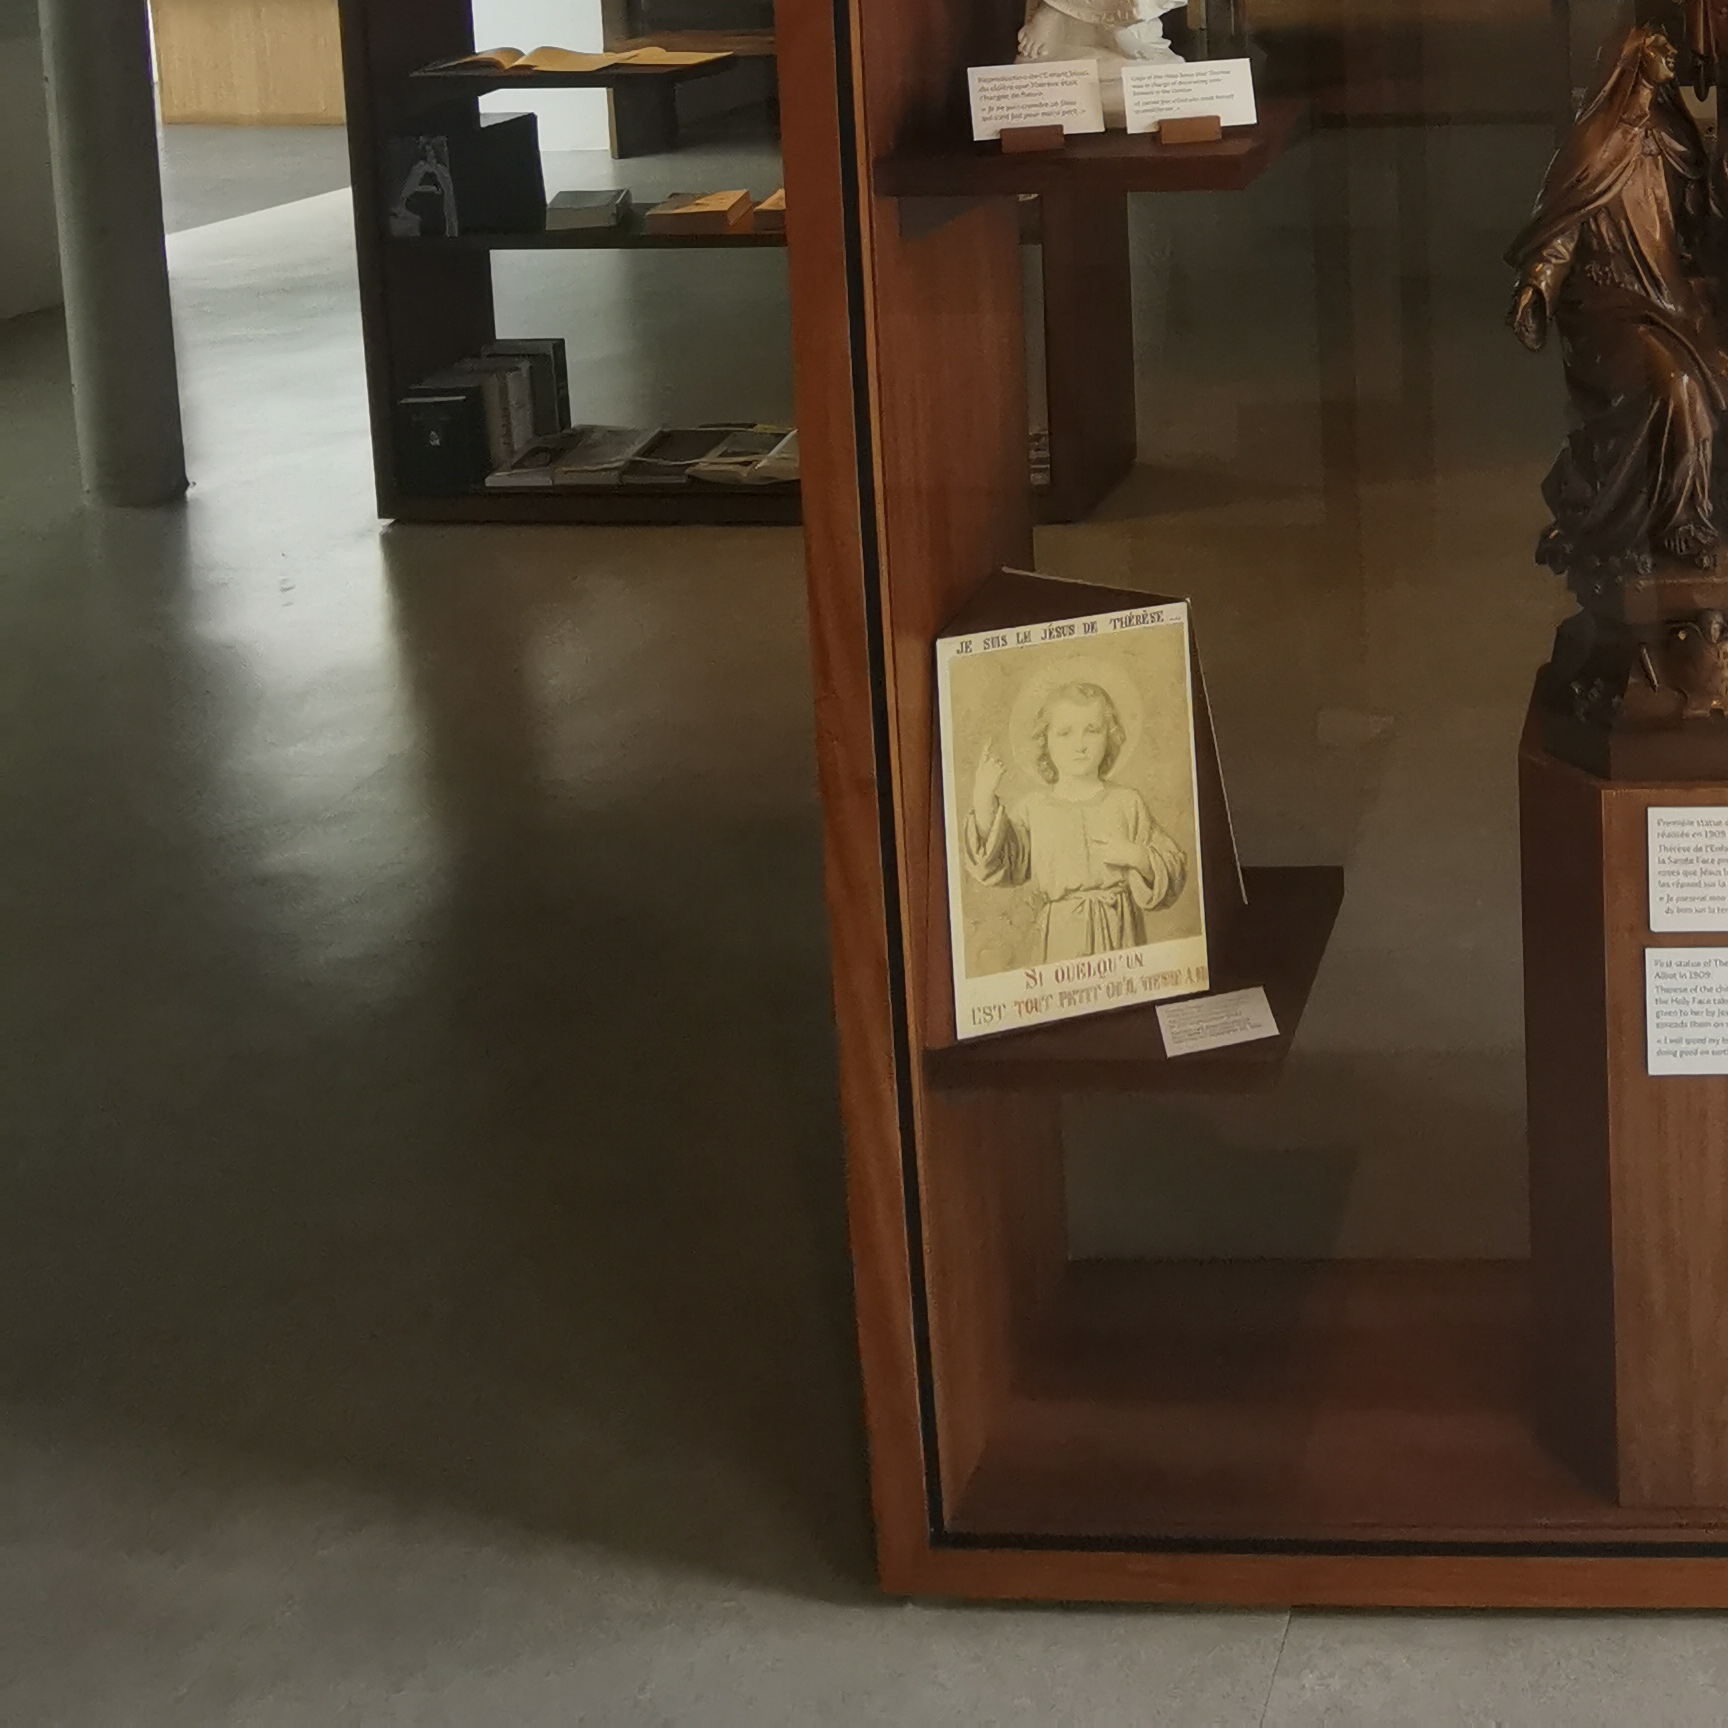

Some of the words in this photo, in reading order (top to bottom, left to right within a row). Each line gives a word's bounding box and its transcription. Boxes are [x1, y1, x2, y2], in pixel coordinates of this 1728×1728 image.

[956, 640, 973, 655] JE
[983, 633, 1009, 651] SUIS
[1041, 623, 1076, 642] JÉSUS
[1083, 620, 1098, 635] DE
[1109, 610, 1165, 631] THÉRÈSE
